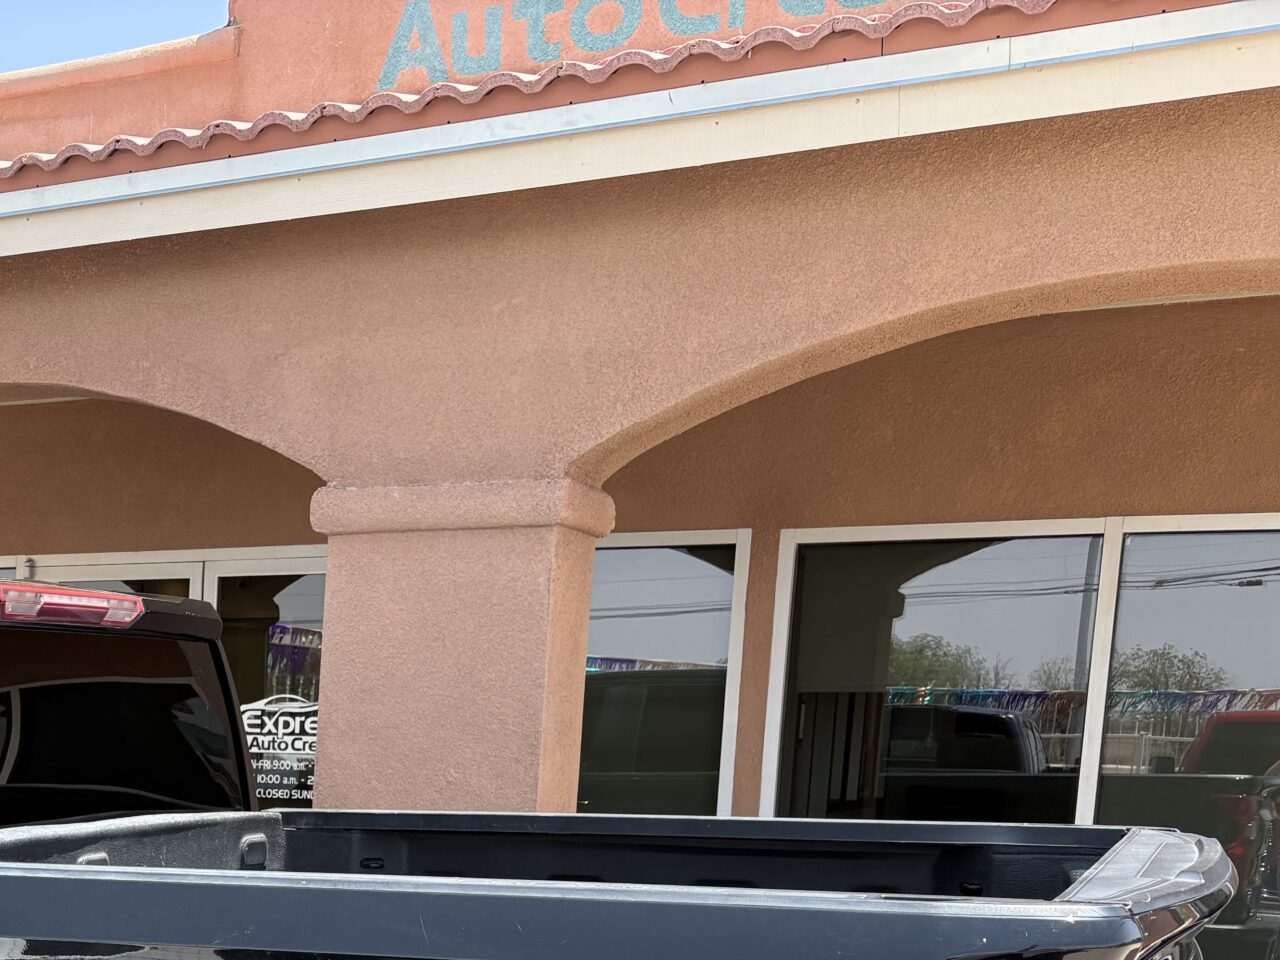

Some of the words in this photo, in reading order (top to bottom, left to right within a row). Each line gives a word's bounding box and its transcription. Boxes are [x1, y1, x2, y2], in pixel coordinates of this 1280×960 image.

[249, 737, 289, 751] Auto
[256, 773, 281, 784] 10:00
[282, 777, 298, 785] a.m.
[255, 788, 290, 799] CLOSED
